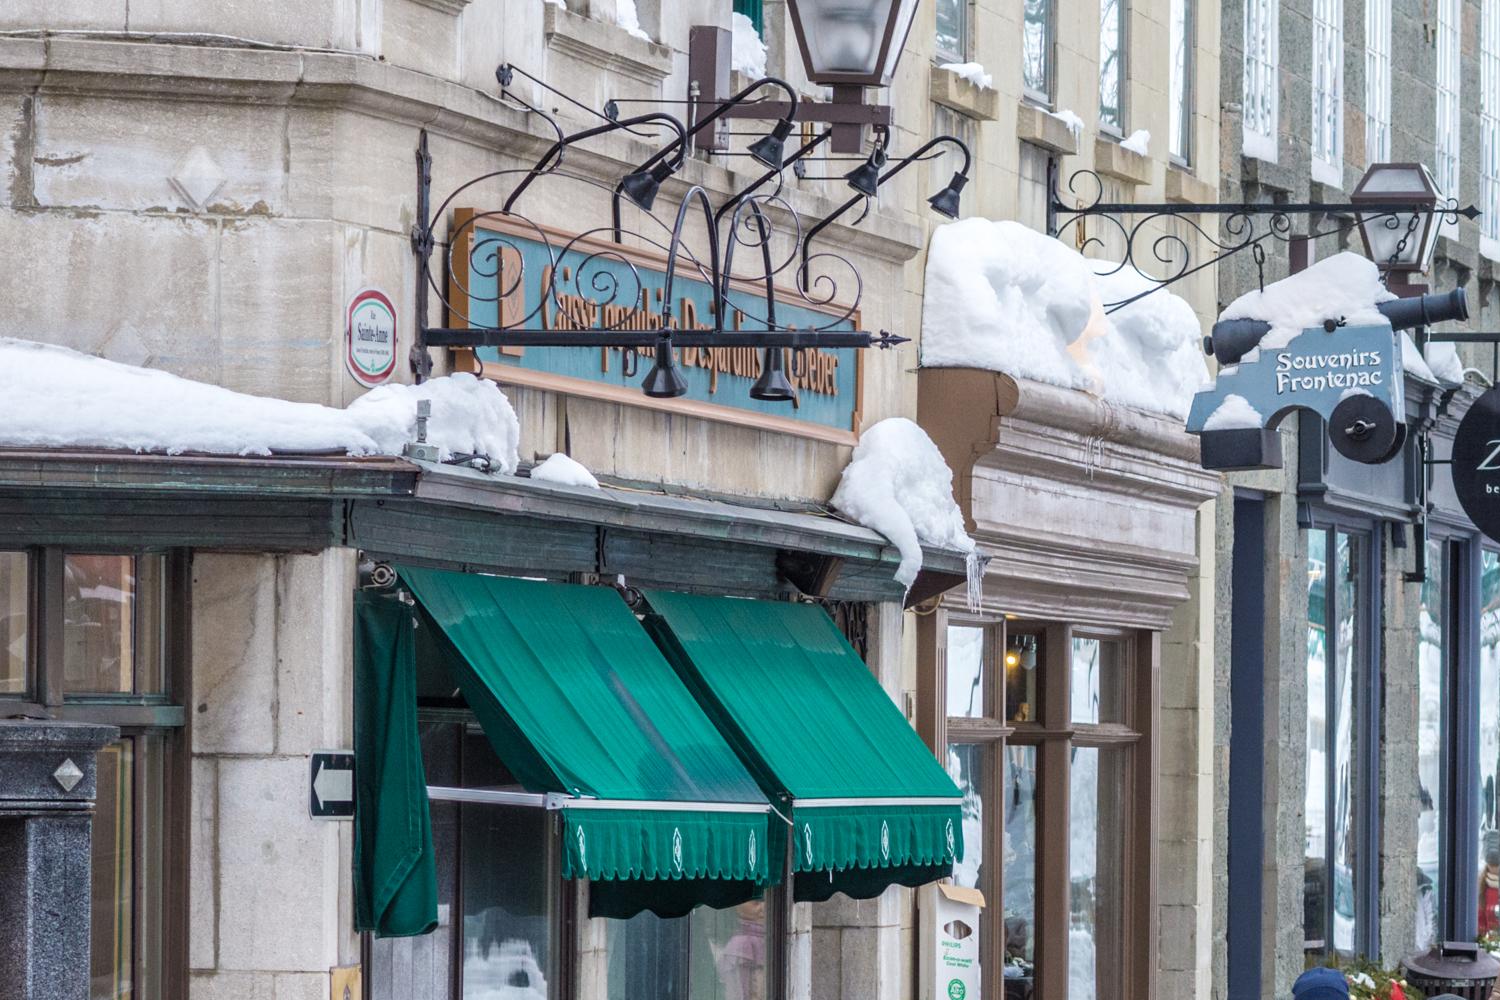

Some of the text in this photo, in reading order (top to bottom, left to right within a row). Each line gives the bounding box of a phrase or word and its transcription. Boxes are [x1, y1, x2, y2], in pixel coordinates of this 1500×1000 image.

[358, 322, 388, 343] Sainte-Anne
[1276, 348, 1381, 371] Souvenirs
[1276, 371, 1383, 395] Frontenac
